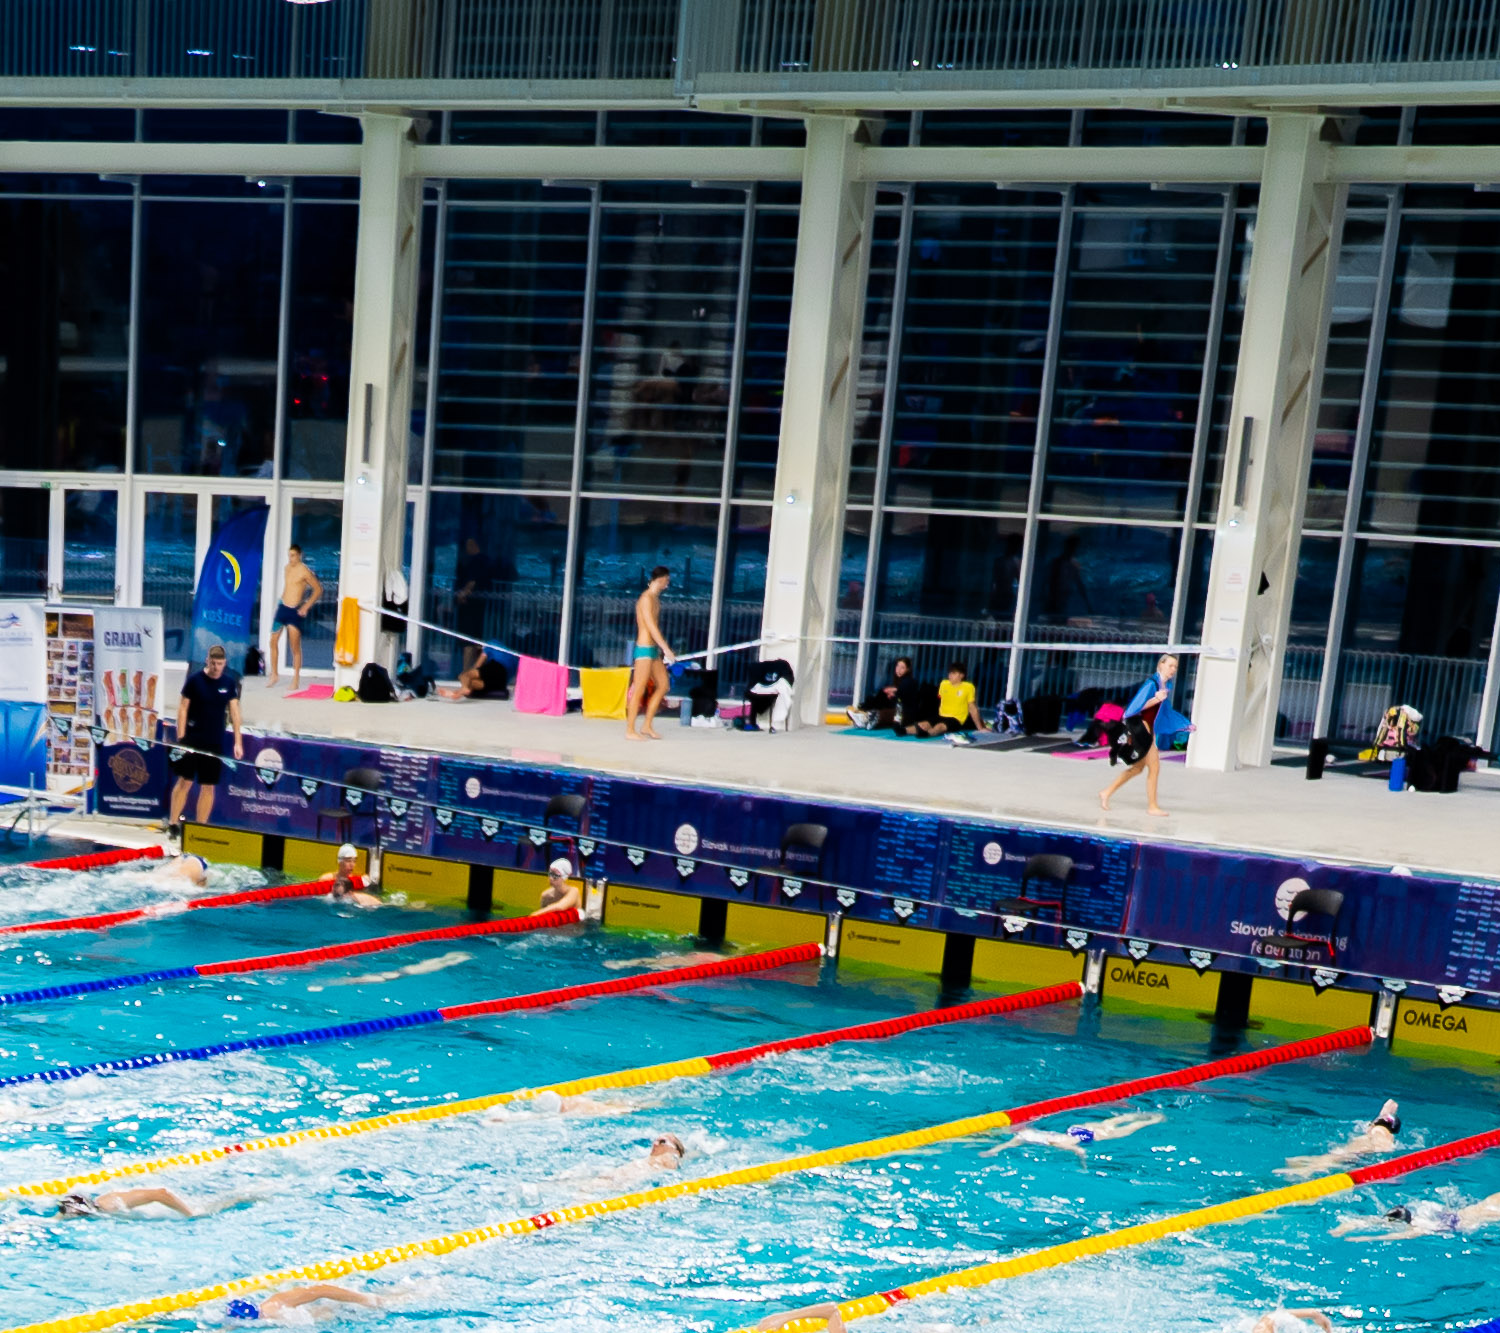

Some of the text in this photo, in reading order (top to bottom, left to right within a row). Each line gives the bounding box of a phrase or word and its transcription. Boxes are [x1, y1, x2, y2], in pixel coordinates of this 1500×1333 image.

[104, 631, 142, 648] GRANA
[1230, 920, 1275, 938] Slovak
[1111, 968, 1170, 990] OMEGA
[1403, 1010, 1468, 1033] OMEGA
